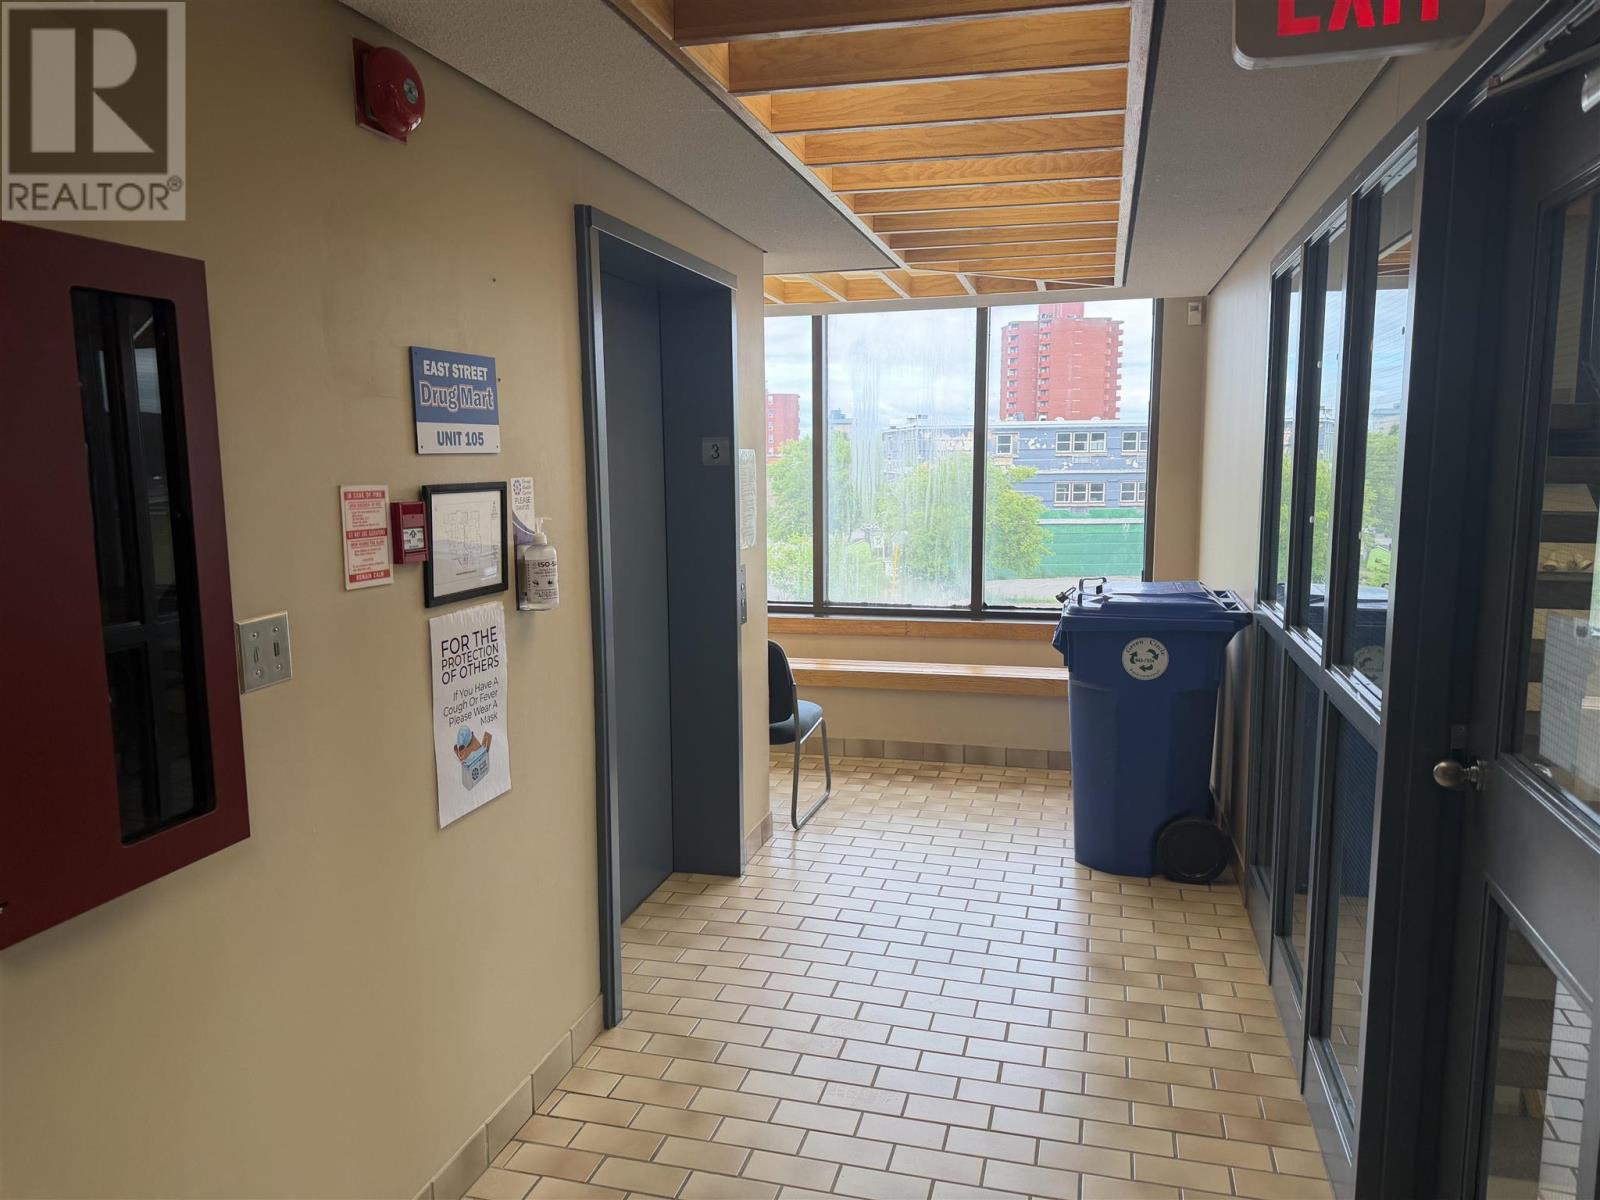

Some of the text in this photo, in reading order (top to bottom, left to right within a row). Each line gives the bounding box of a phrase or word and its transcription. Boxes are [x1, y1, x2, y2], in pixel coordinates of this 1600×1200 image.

[423, 360, 488, 381] EAST STREET
[419, 380, 495, 412] Drug Mart
[437, 431, 484, 447] UNIT 105
[711, 443, 720, 460] 3
[441, 626, 498, 658] FOR THE
[441, 643, 499, 671] PROTECTION
[442, 655, 499, 685] OF OTHERS
[453, 677, 499, 702] If You Have A
[443, 690, 498, 717] Cough Or Fever
[449, 700, 498, 727] Please Wear A
[480, 712, 498, 726] Mask
